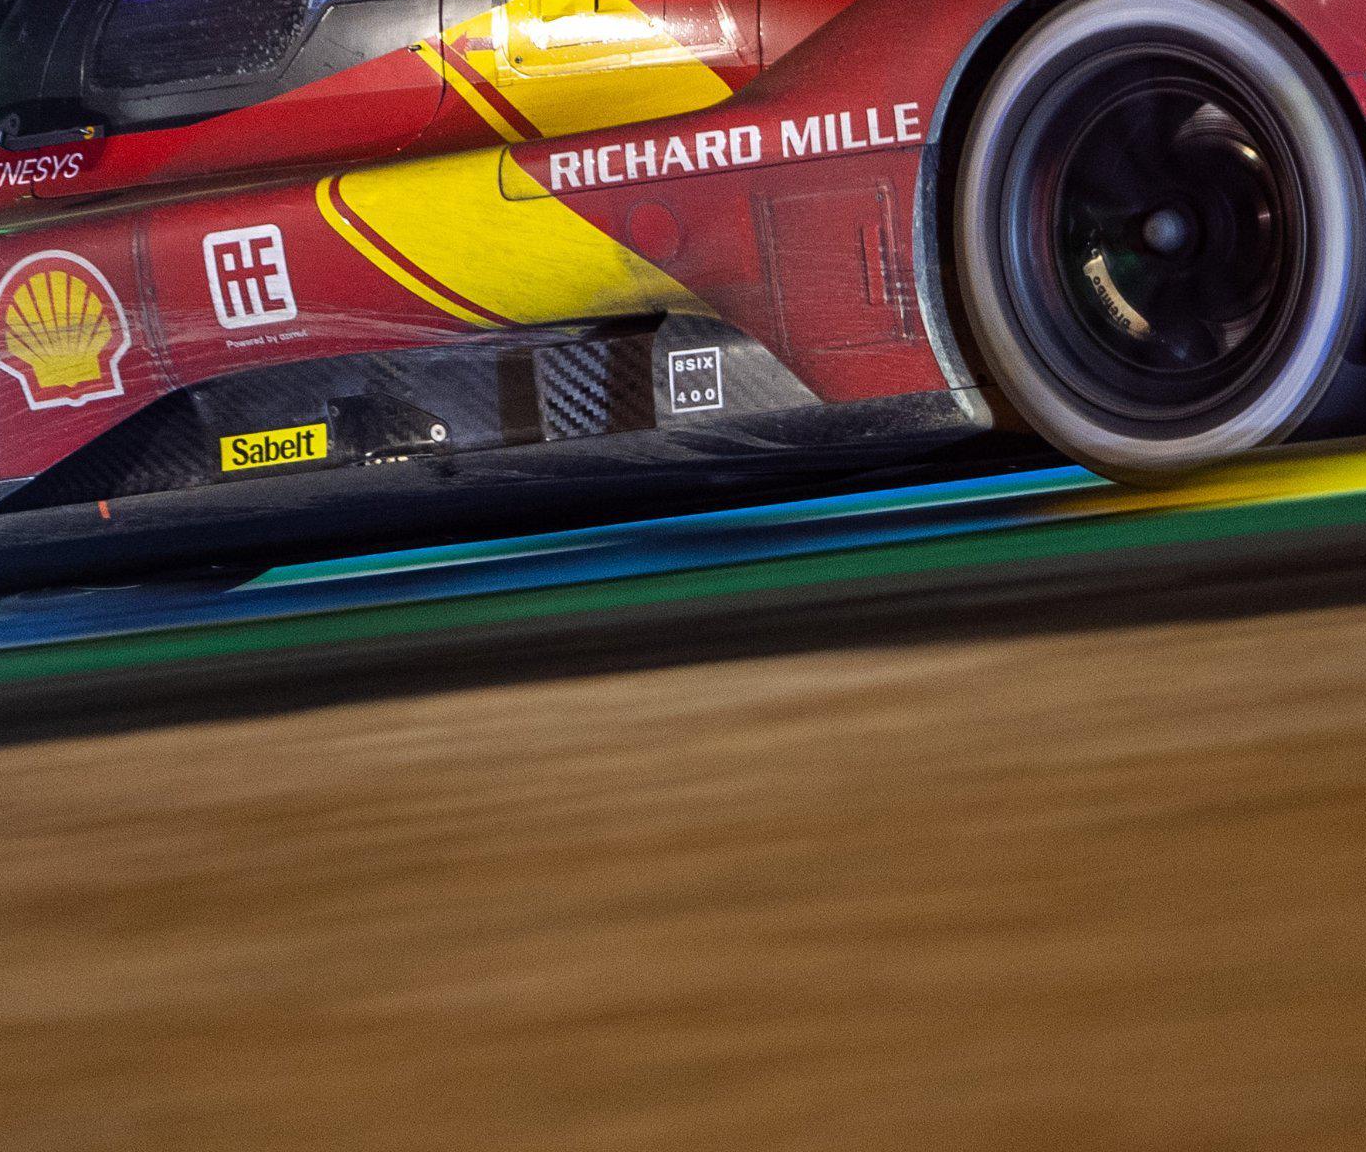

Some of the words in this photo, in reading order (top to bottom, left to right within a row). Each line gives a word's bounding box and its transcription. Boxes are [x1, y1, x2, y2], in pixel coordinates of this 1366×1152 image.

[549, 124, 763, 191] RICHARD
[781, 102, 922, 158] MILLE
[675, 356, 714, 372] 8SIX
[676, 388, 715, 404] 400
[232, 430, 316, 466] Sabelt
